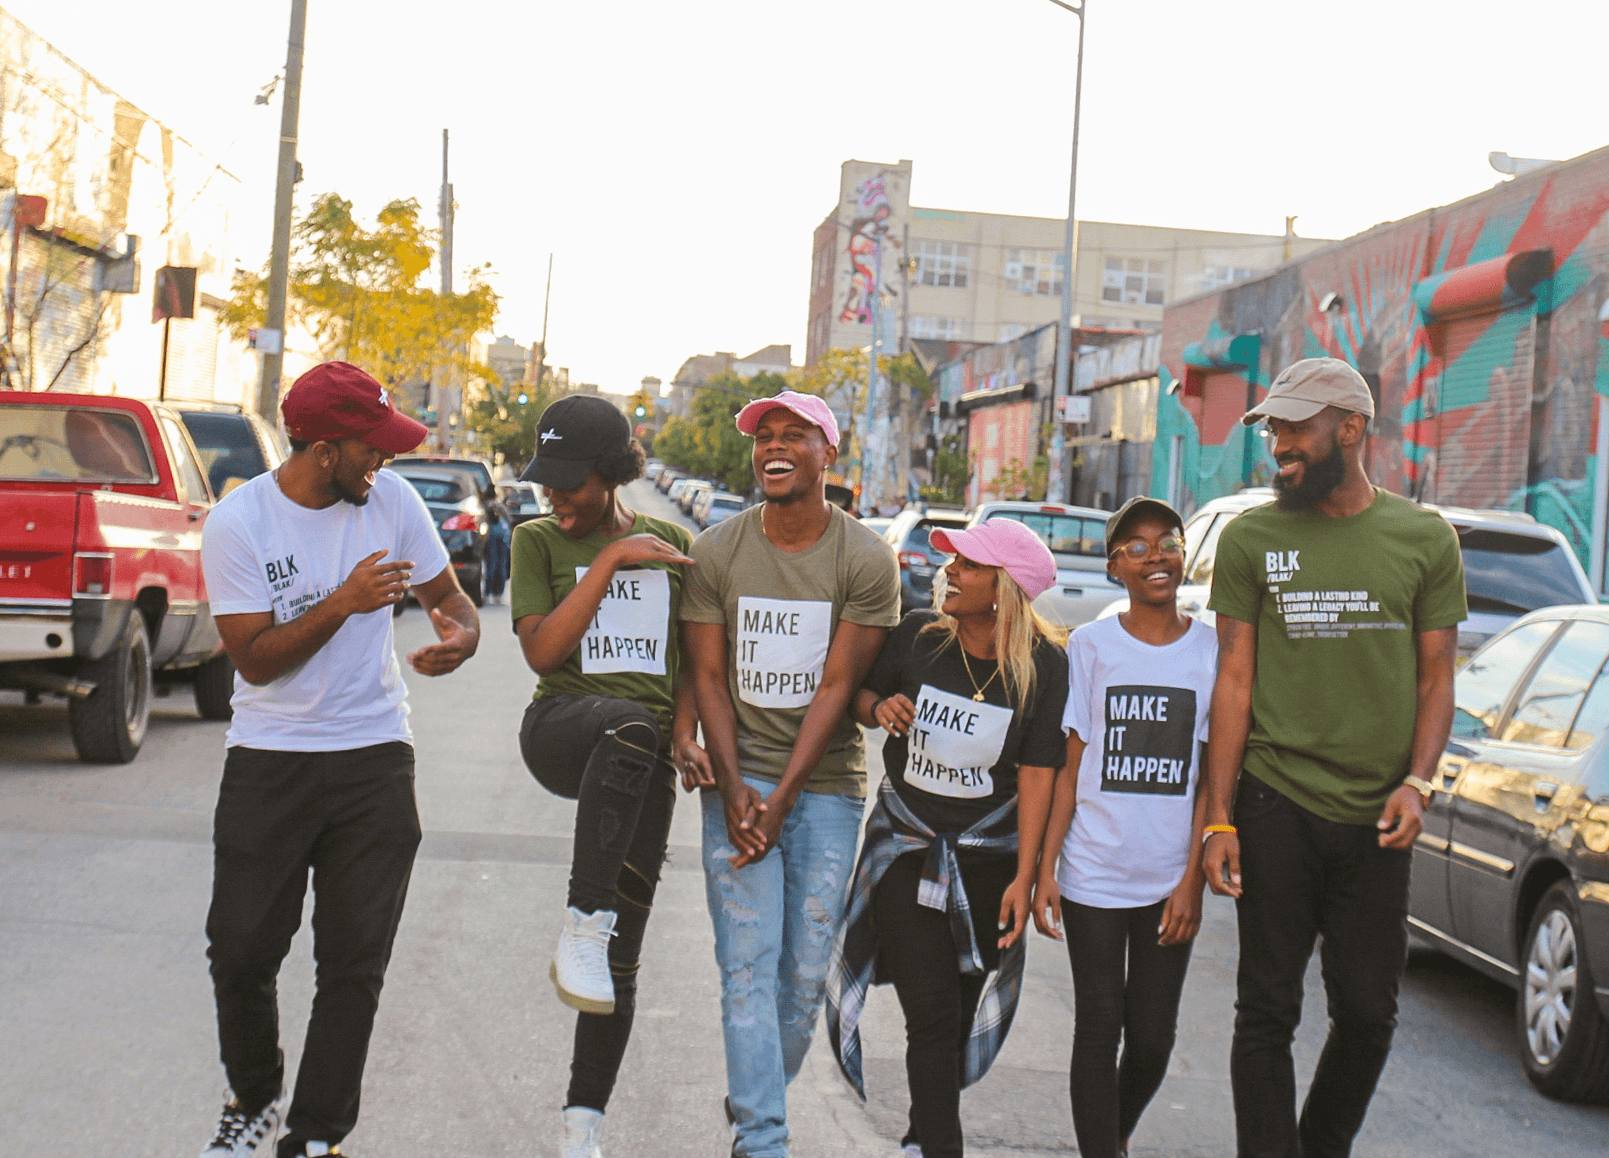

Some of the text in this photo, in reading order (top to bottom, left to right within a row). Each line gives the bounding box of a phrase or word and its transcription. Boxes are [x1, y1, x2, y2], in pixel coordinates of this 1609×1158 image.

[265, 554, 299, 583] BLK
[1265, 550, 1300, 572] BLK
[316, 590, 321, 599] A
[604, 579, 641, 600] AKE
[1282, 591, 1313, 602] BUILDING
[1314, 591, 1321, 601] A
[1321, 590, 1350, 601] LASTING
[1350, 591, 1368, 601] KIND
[1283, 601, 1312, 613] LEAVING
[1312, 602, 1319, 611] A
[1319, 602, 1345, 612] LEGACY
[1345, 601, 1369, 612] YOU'LL
[1369, 601, 1380, 612] BE
[1329, 612, 1340, 623] BY
[744, 609, 800, 635] MAKE
[587, 636, 658, 661] HAPPEN
[742, 640, 759, 663] IT
[742, 668, 816, 695] HAPPEN
[918, 698, 979, 735] MAKE
[1109, 695, 1169, 721] MAKE
[913, 728, 930, 750] IT
[1108, 726, 1126, 751] IT
[911, 752, 984, 787] HAPPEN
[1106, 756, 1184, 784] HAPPEN
